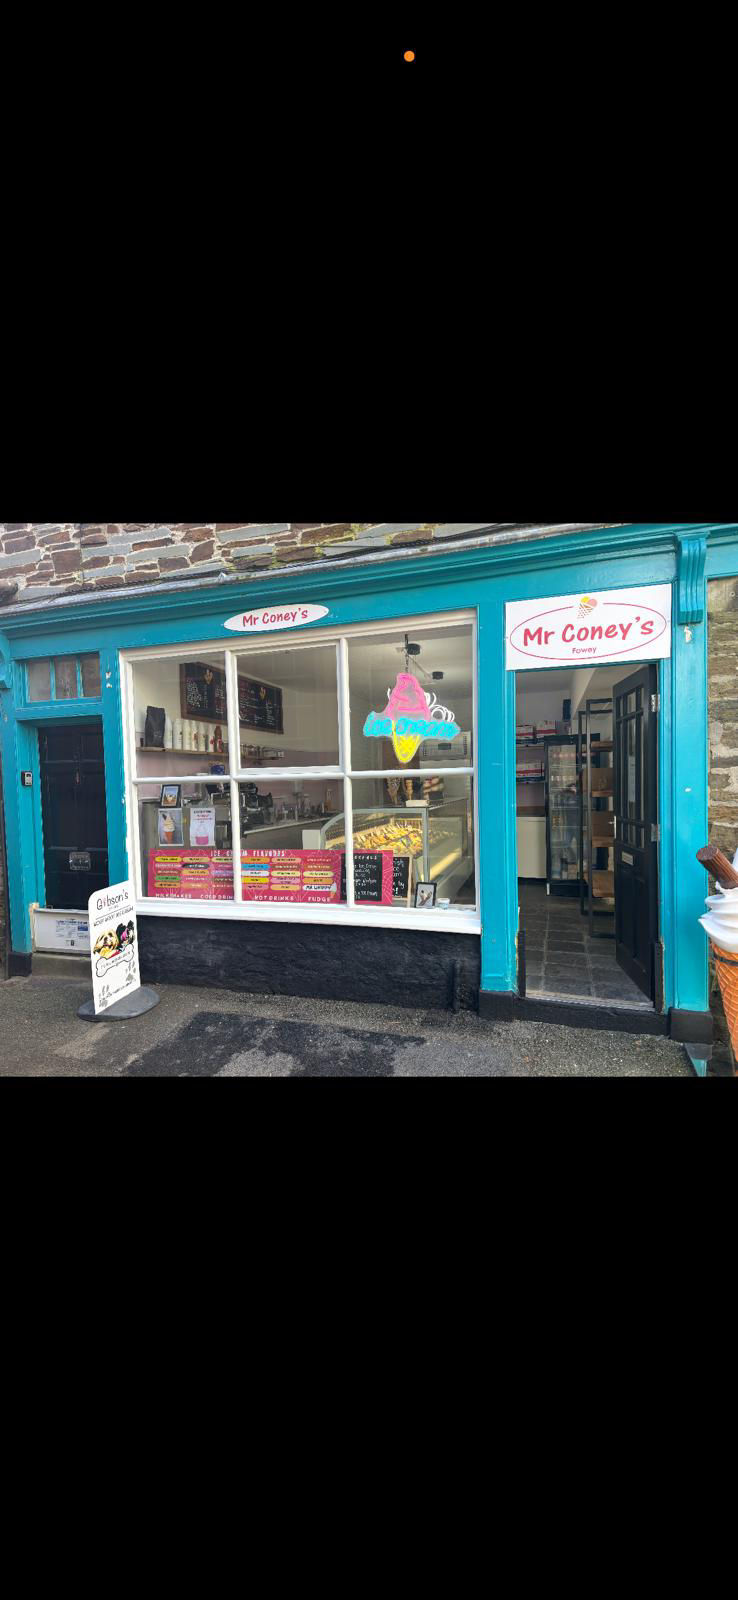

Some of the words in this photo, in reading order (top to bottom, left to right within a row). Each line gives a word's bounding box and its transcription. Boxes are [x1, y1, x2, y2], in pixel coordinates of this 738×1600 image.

[242, 614, 259, 627] Mr
[262, 607, 309, 624] Coney's
[523, 626, 555, 647] Mr
[561, 616, 655, 643] Coney's
[572, 646, 597, 655] Fowey
[210, 849, 221, 857] ICE
[96, 889, 129, 911] Gibson's
